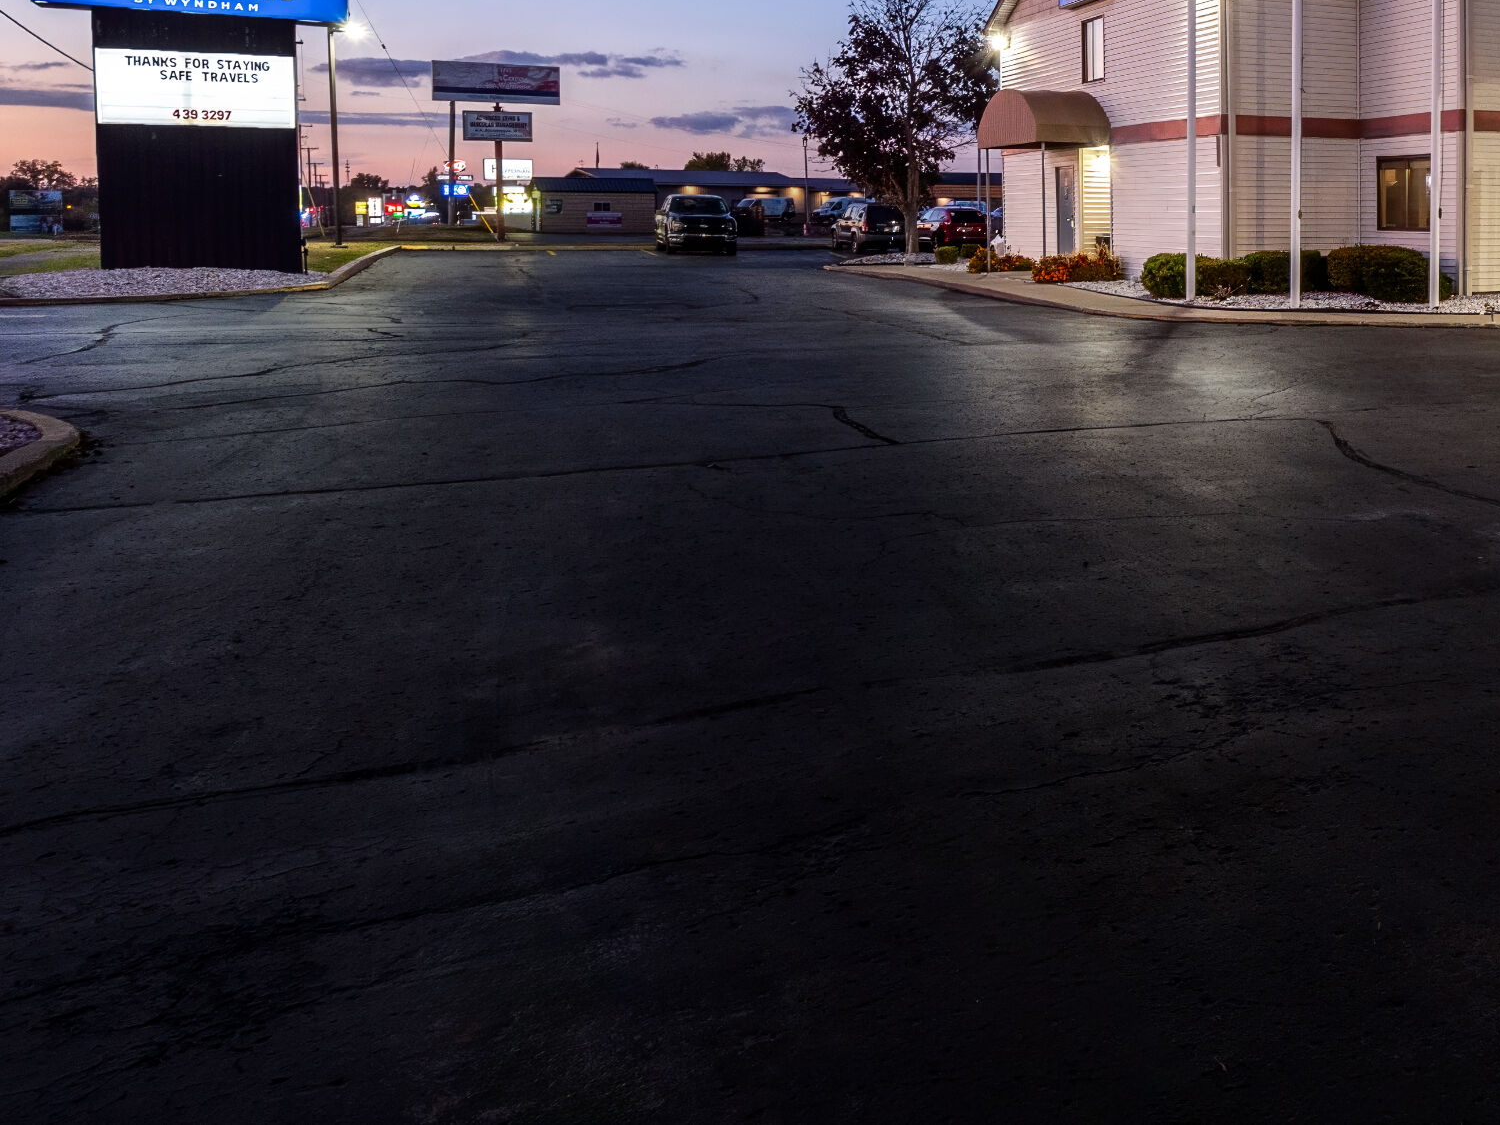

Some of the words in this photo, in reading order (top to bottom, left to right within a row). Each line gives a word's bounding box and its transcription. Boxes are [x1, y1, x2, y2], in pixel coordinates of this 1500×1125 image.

[124, 55, 178, 68] THANKS
[184, 57, 210, 70] FOR
[217, 59, 271, 72] STAYING
[159, 70, 193, 81] SAFE
[202, 71, 259, 83] TRAVELS
[201, 110, 232, 121] 3297
